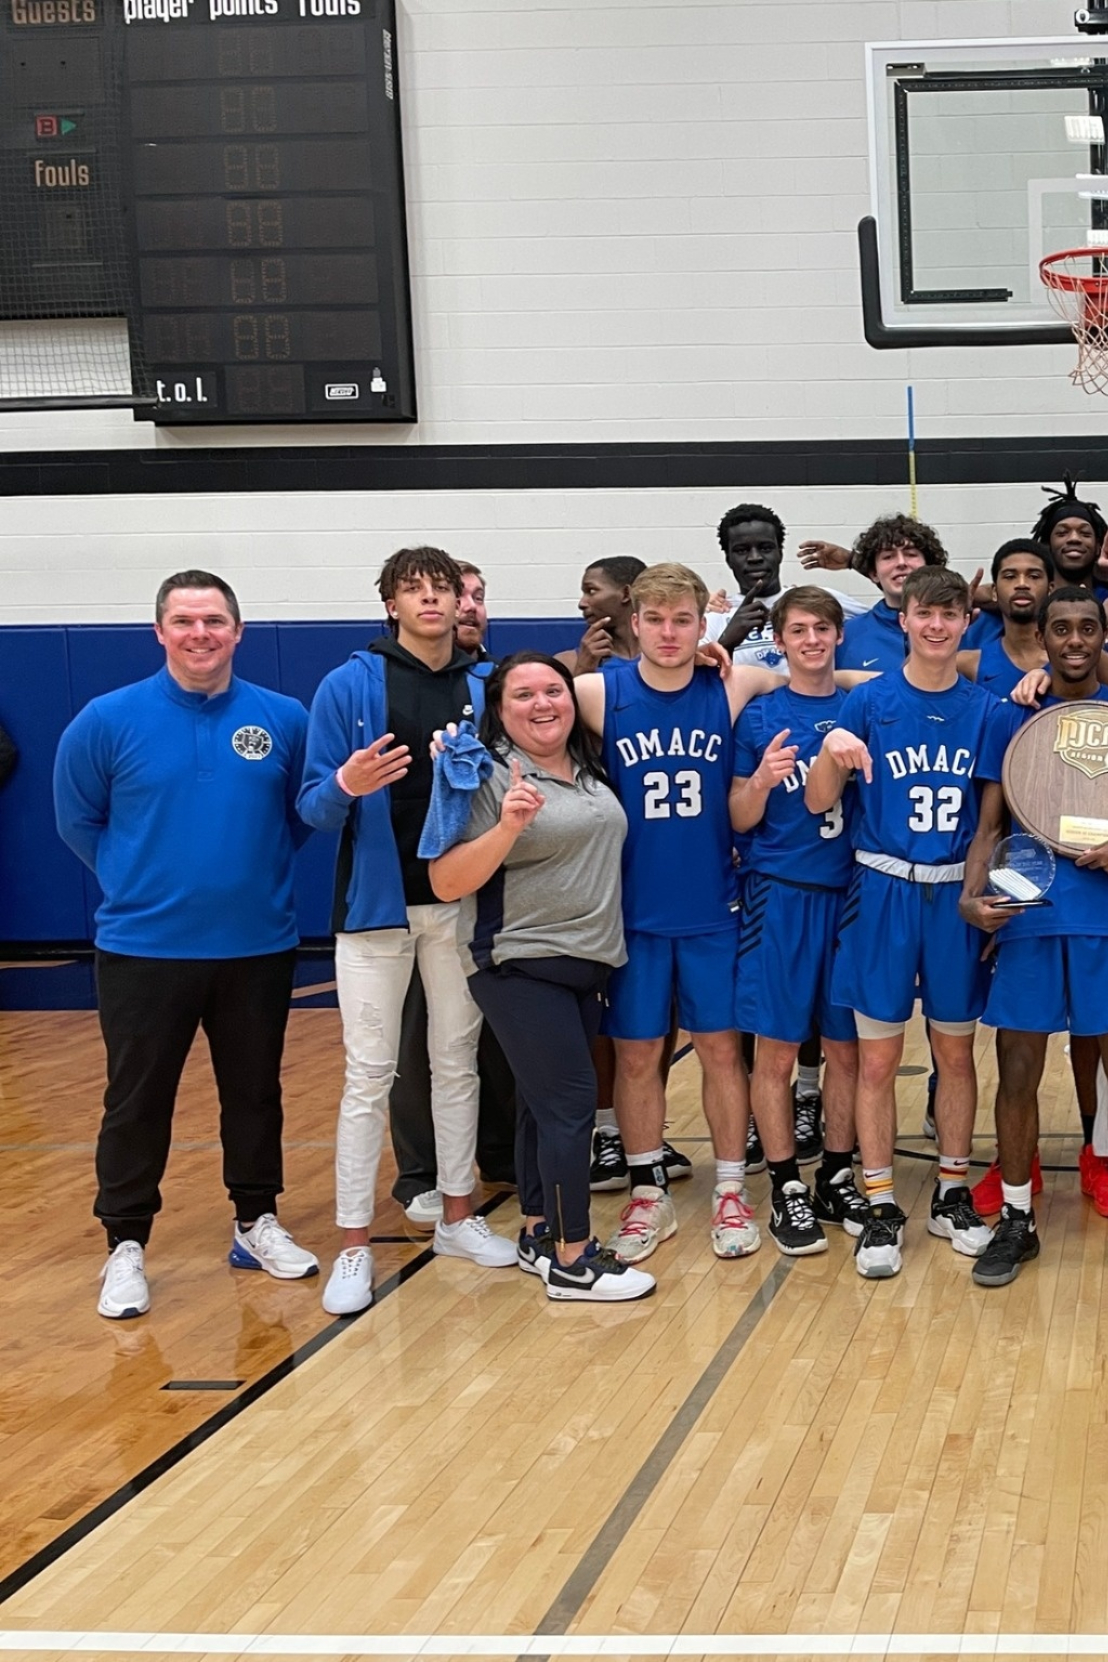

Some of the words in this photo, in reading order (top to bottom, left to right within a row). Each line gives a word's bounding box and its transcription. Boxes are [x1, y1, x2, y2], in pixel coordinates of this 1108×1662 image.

[12, 0, 96, 25] Guests
[123, 0, 194, 25] player
[34, 159, 90, 187] Fouls
[615, 727, 722, 767] DMACC
[884, 744, 977, 779] DMAC
[643, 770, 702, 819] 23
[908, 785, 963, 832] 32
